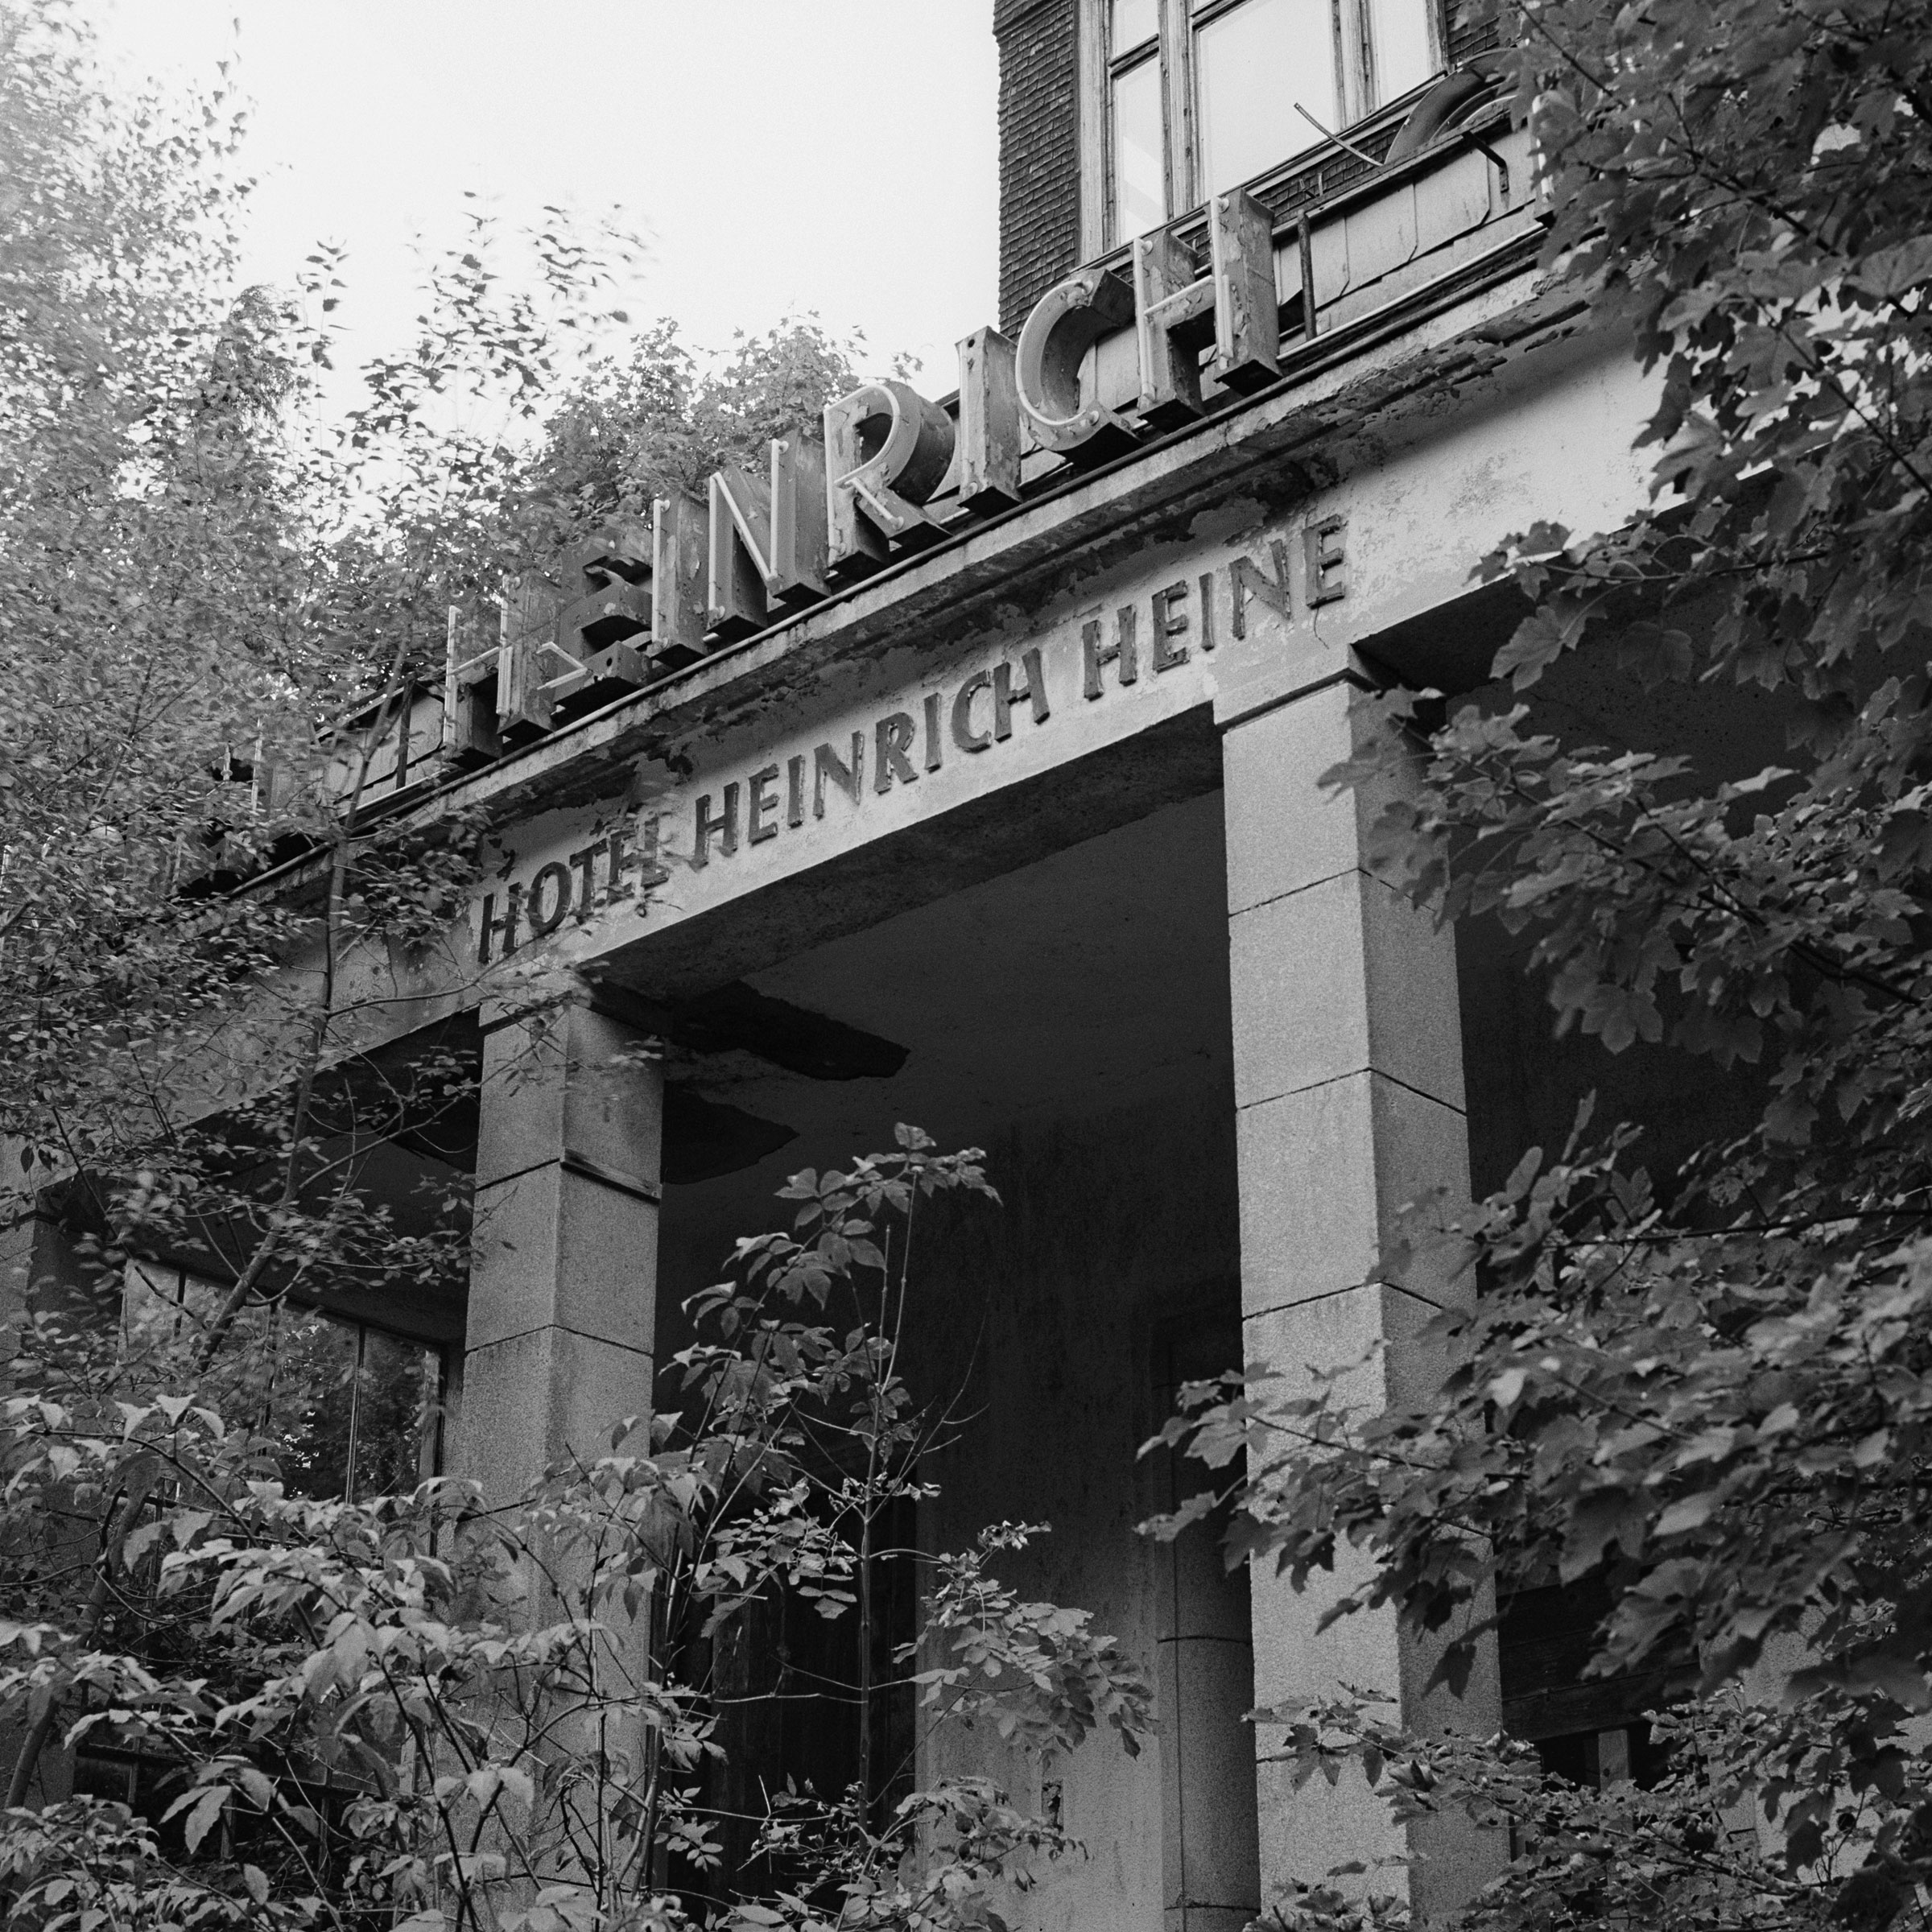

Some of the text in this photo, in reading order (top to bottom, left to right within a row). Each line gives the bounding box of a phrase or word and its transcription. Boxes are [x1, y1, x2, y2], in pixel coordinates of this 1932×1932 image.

[442, 188, 1283, 763] HEINRICH
[477, 514, 1346, 965] HOTEL HEINRICH HEINE
